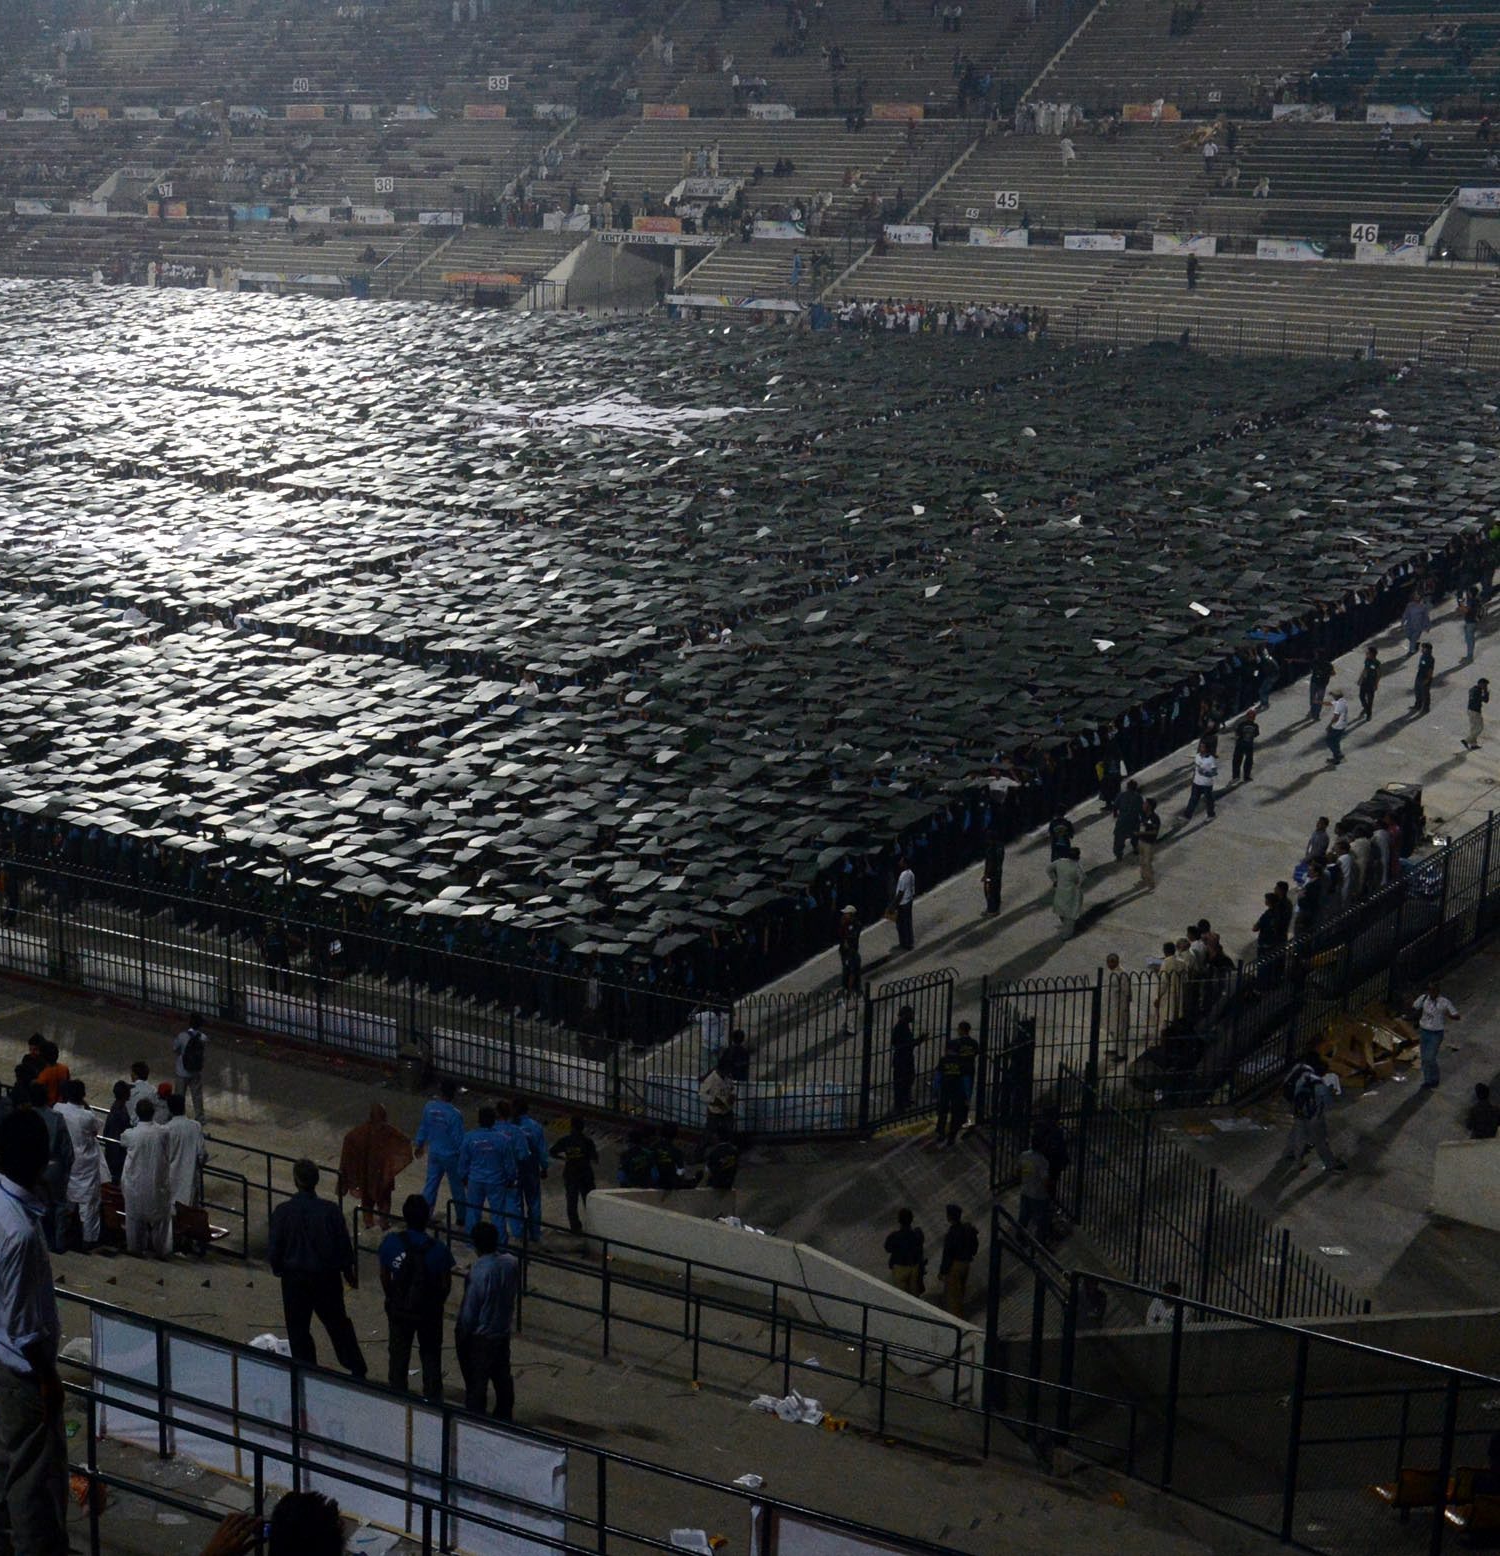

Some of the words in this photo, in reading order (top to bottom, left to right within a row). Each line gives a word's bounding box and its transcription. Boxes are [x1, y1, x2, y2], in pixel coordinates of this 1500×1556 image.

[293, 79, 307, 91] 40
[490, 77, 507, 89] 39
[159, 184, 171, 196] 37
[376, 179, 391, 190] 38
[997, 193, 1017, 207] 45
[968, 209, 978, 217] 45
[601, 234, 629, 242] AKHTAR
[1353, 226, 1376, 242] 46
[1406, 234, 1417, 244] 46
